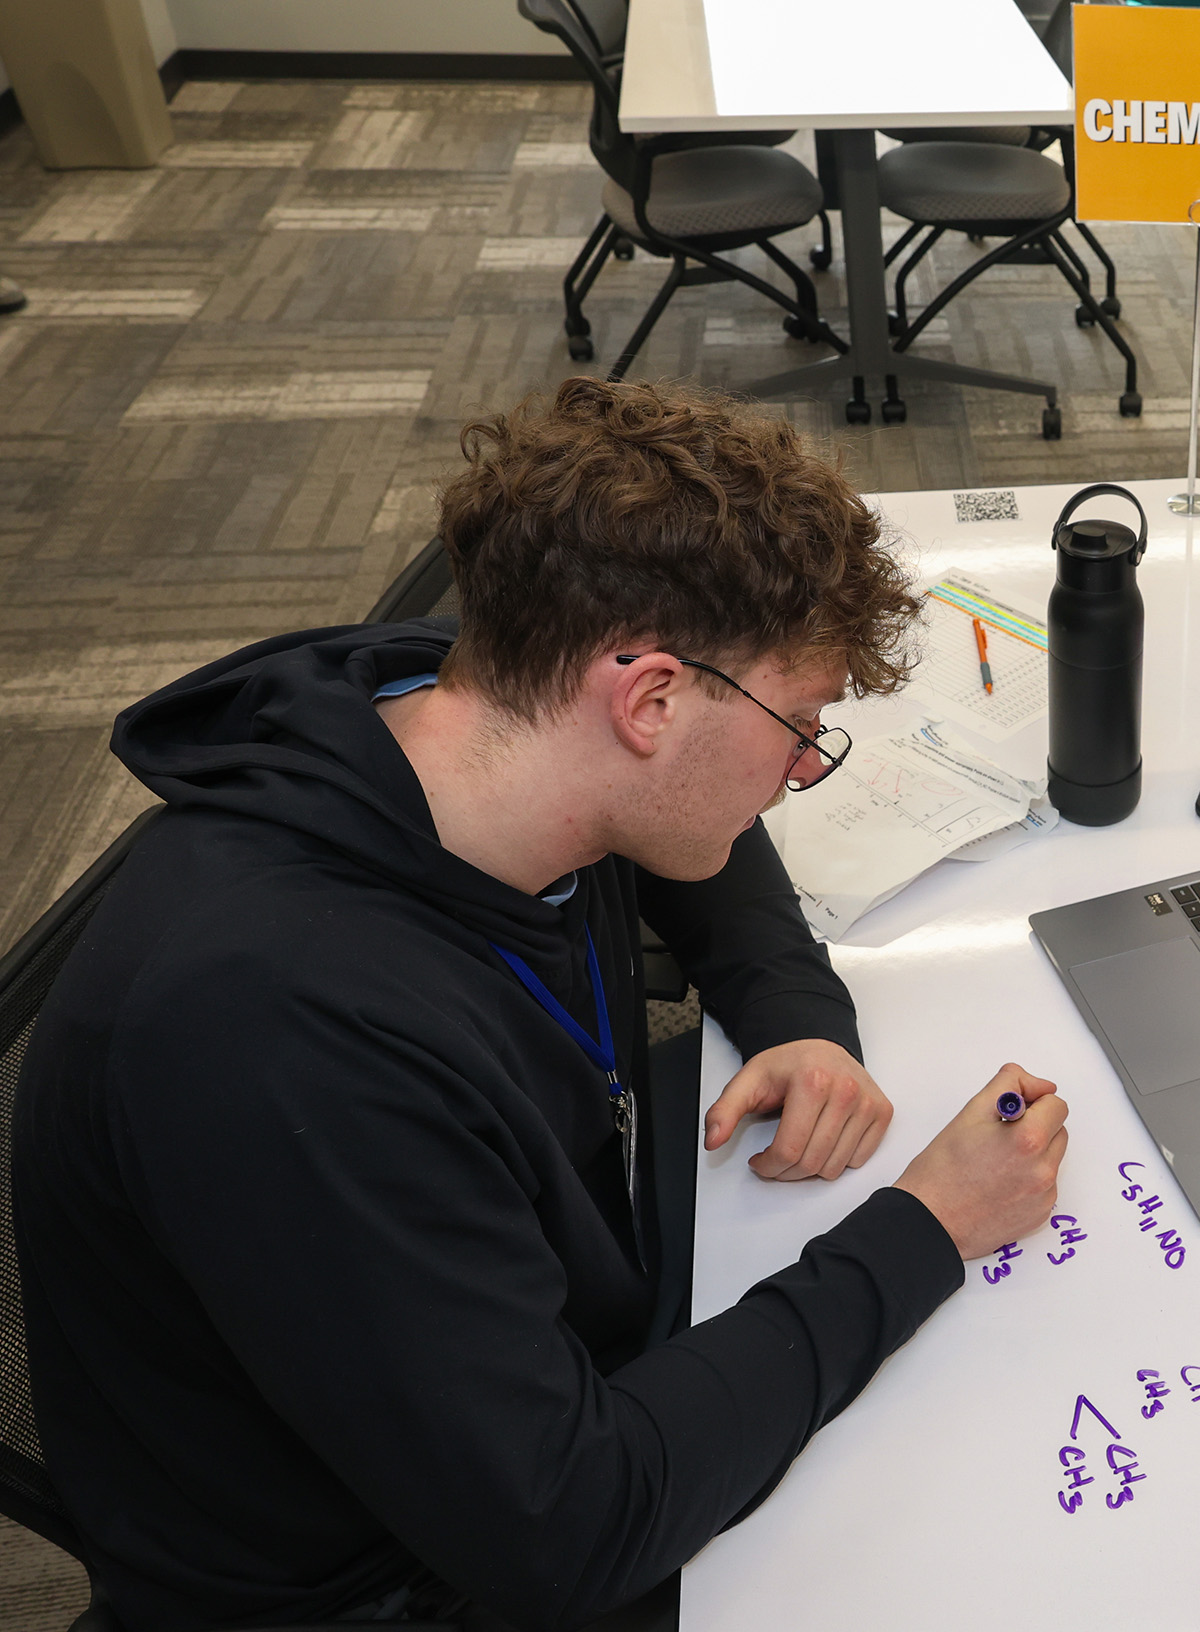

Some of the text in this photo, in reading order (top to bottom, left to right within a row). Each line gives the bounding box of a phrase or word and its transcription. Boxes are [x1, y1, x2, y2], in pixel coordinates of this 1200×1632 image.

[983, 1241, 1024, 1285] H3
[1047, 1214, 1089, 1266] CH3
[1136, 1369, 1172, 1420] CH3
[1057, 1445, 1095, 1515] CH3
[1105, 1443, 1148, 1510] CH3
